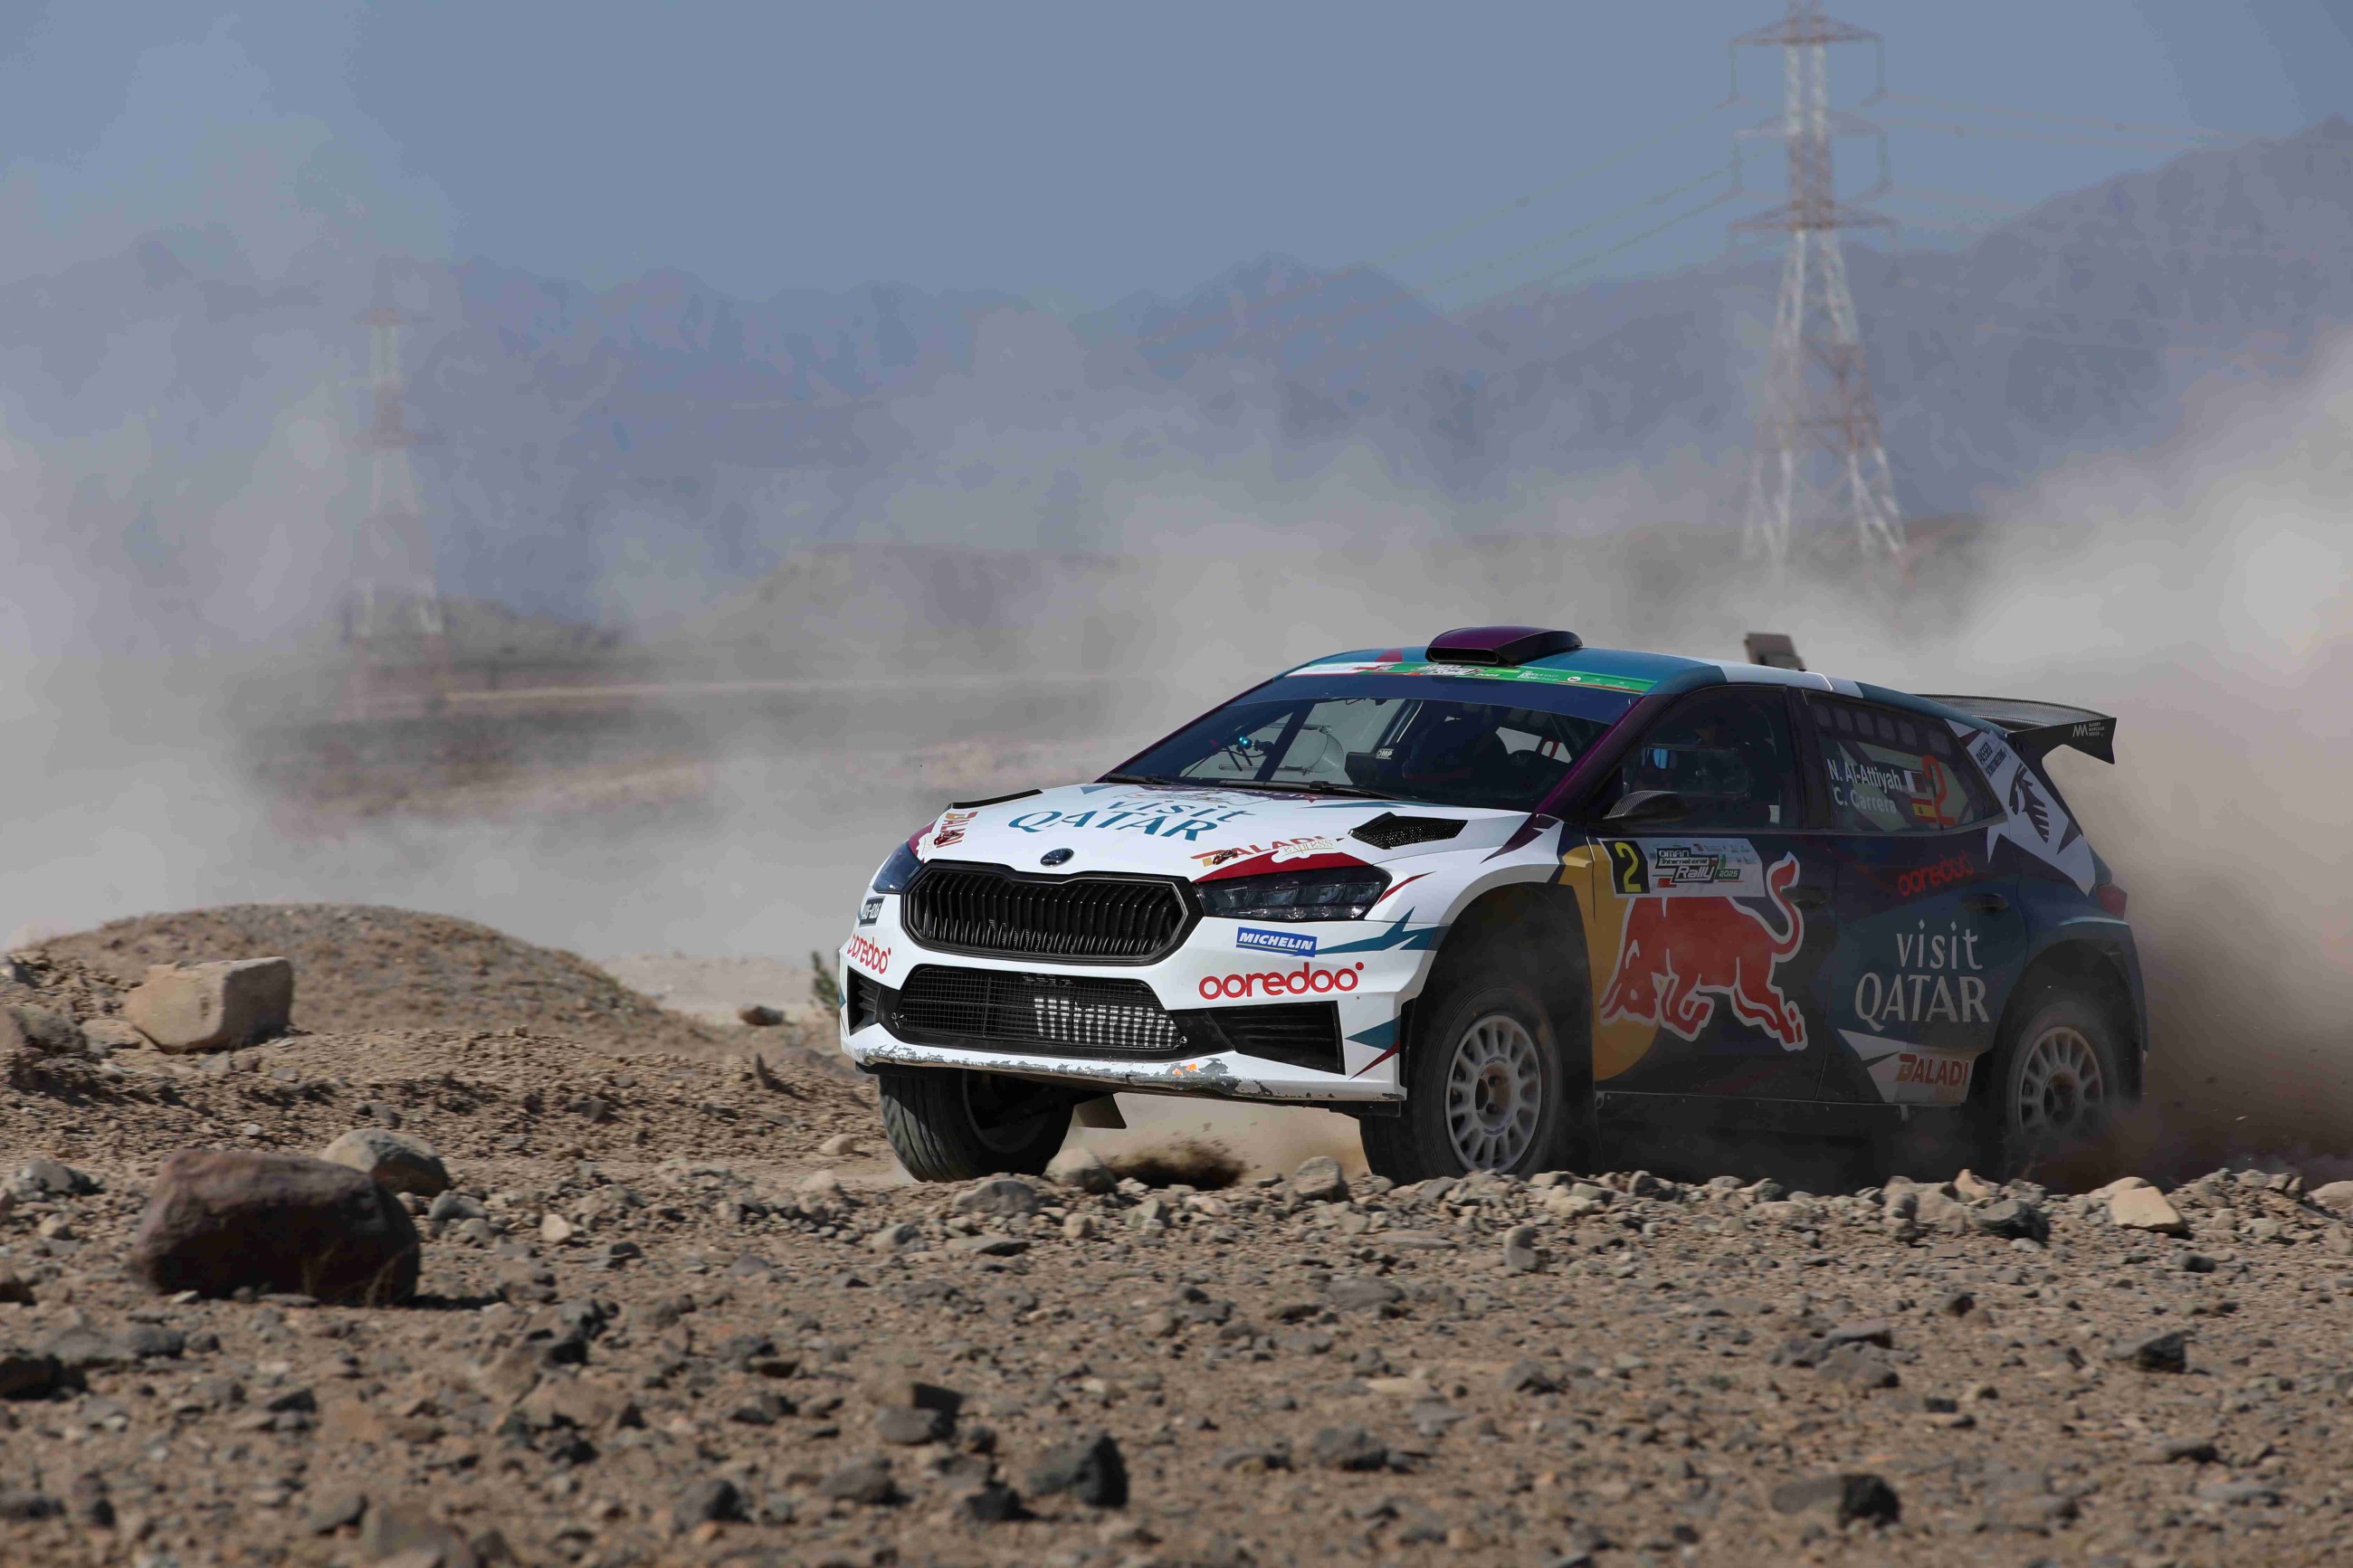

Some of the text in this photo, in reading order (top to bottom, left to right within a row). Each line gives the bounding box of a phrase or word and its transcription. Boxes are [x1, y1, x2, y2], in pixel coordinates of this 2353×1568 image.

[1377, 750, 1393, 758] OMP
[1826, 758, 1902, 794] N. Al-Attiyah
[1921, 755, 1956, 826] 2
[1107, 800, 1257, 823] visit
[1834, 786, 1897, 814] C. Carrera
[1008, 811, 1218, 841] QATAR
[1615, 841, 1642, 893] 2
[1659, 850, 1690, 858] OMAN
[1662, 858, 1708, 866] International
[1675, 866, 1739, 880] Rally 2025
[847, 934, 891, 974] ooredoo
[1239, 932, 1313, 950] MICHELIN
[1896, 919, 1983, 970] visit
[1199, 962, 1364, 1000] ooredoo
[1855, 972, 1989, 1031] QATAR
[1895, 1052, 1969, 1087] BALADI
